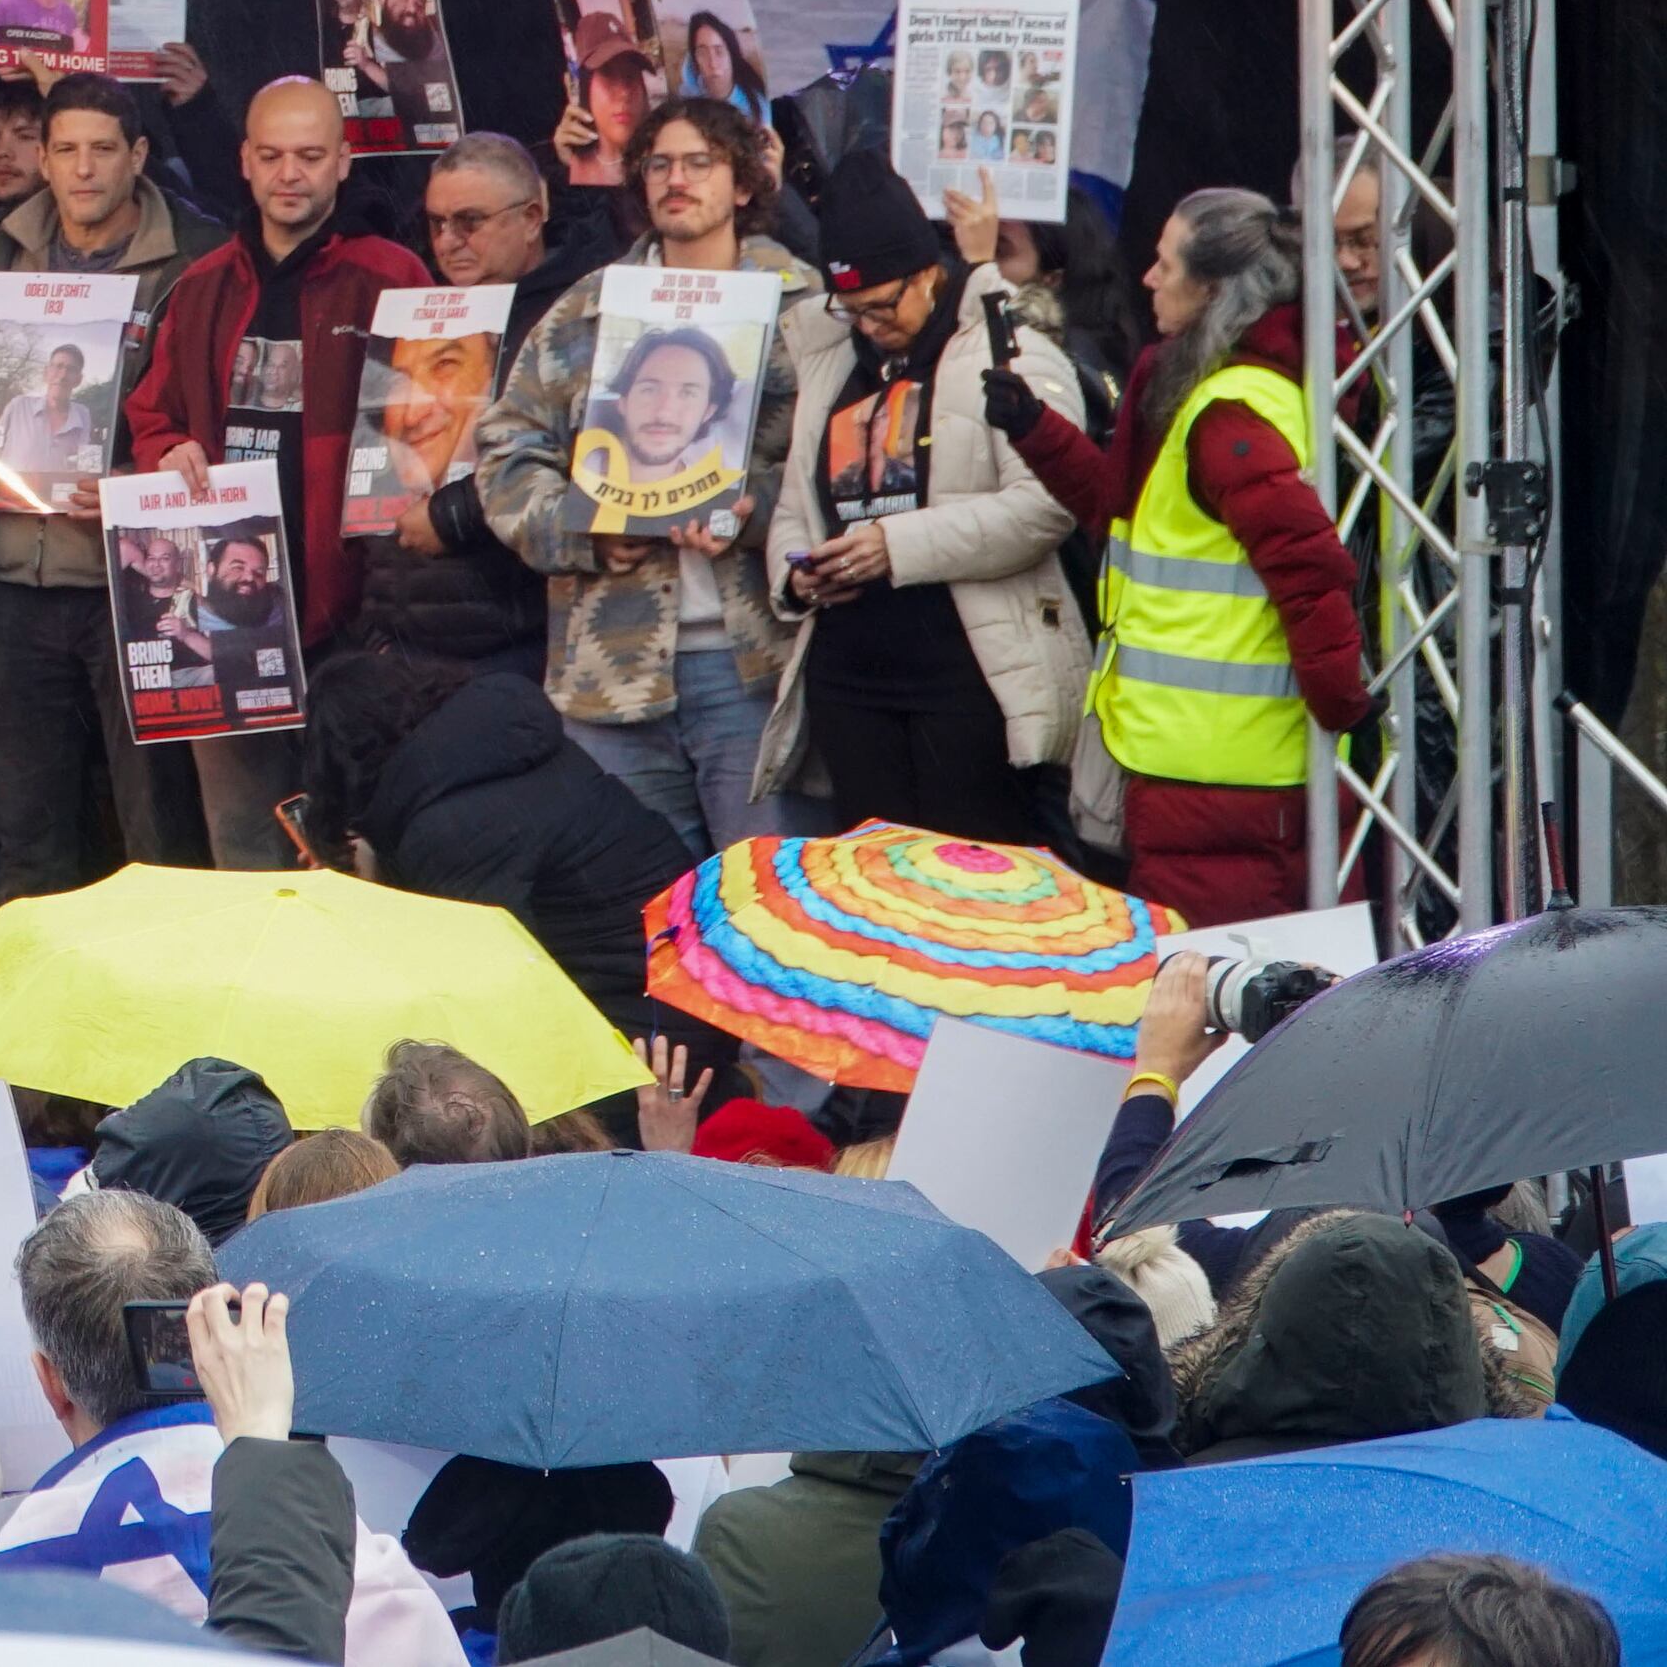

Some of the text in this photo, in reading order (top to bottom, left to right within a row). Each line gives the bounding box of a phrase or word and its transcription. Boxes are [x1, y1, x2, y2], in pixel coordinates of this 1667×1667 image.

[909, 15, 1066, 30] Don't forget them! Faces of
[908, 32, 1065, 47] girls STILL held by Hamas
[60, 55, 105, 72] HOME
[25, 284, 91, 298] ODED LIFSHITZ
[140, 486, 248, 511] IAIR AND HORN
[127, 639, 174, 666] BRING
[129, 665, 172, 690] THEM
